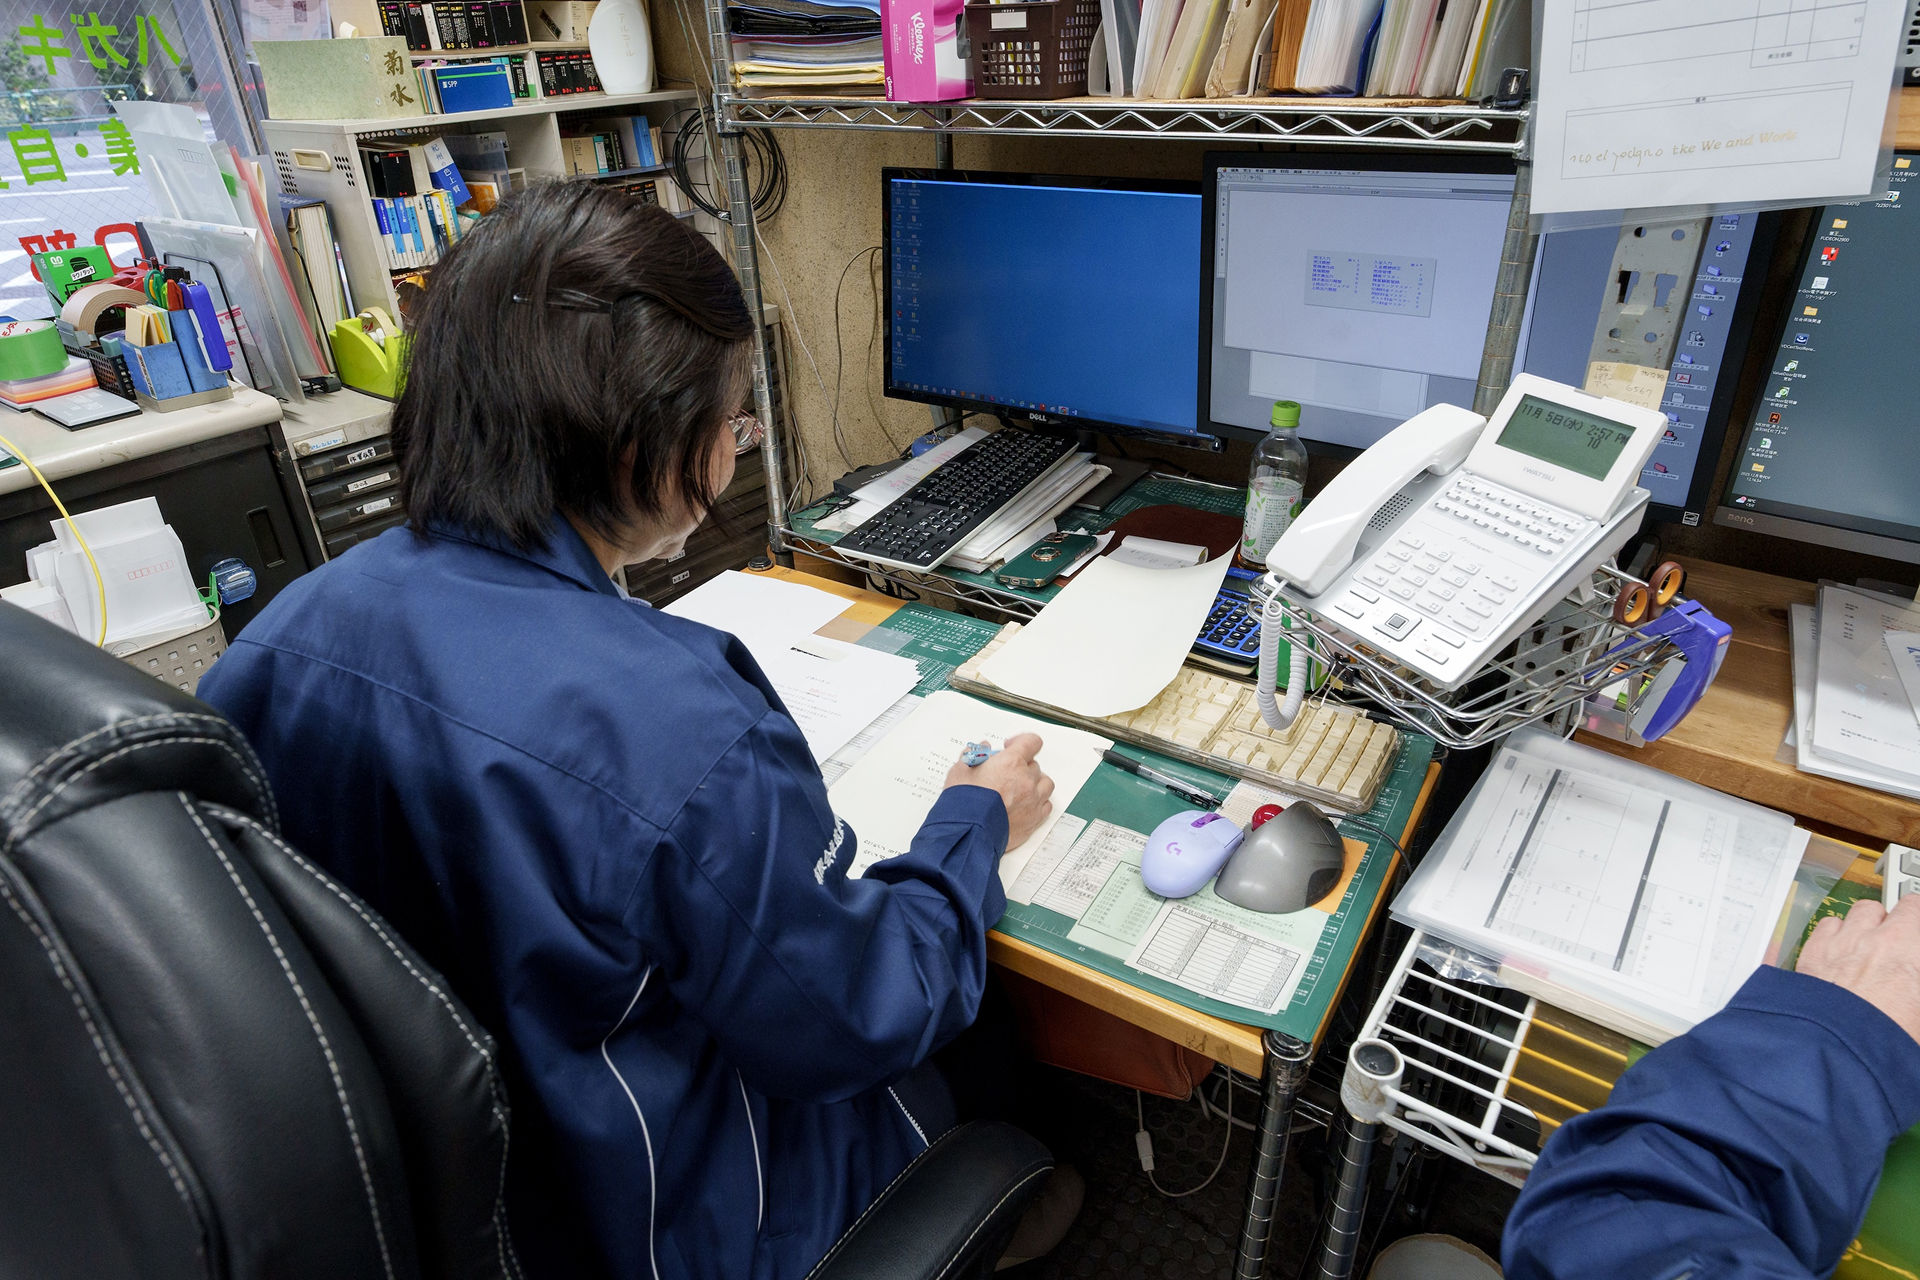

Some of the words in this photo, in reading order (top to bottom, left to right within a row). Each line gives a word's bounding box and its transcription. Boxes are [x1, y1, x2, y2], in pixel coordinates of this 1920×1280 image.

[619, 13, 636, 57] アルコール
[911, 12, 925, 64] Kleenex
[384, 50, 414, 106] 菊水
[1701, 140, 1721, 151] We
[1726, 135, 1753, 148] and
[431, 144, 460, 193] 紀州の色上質
[1029, 413, 1046, 422] DELL
[1521, 403, 1544, 419] 11月
[1545, 412, 1584, 432] 5日(水)
[1587, 425, 1614, 441] 2:57
[1614, 433, 1631, 446] PM
[1587, 437, 1601, 449] 10
[1523, 466, 1556, 482] IWATSU
[1728, 514, 1754, 525] BenQ
